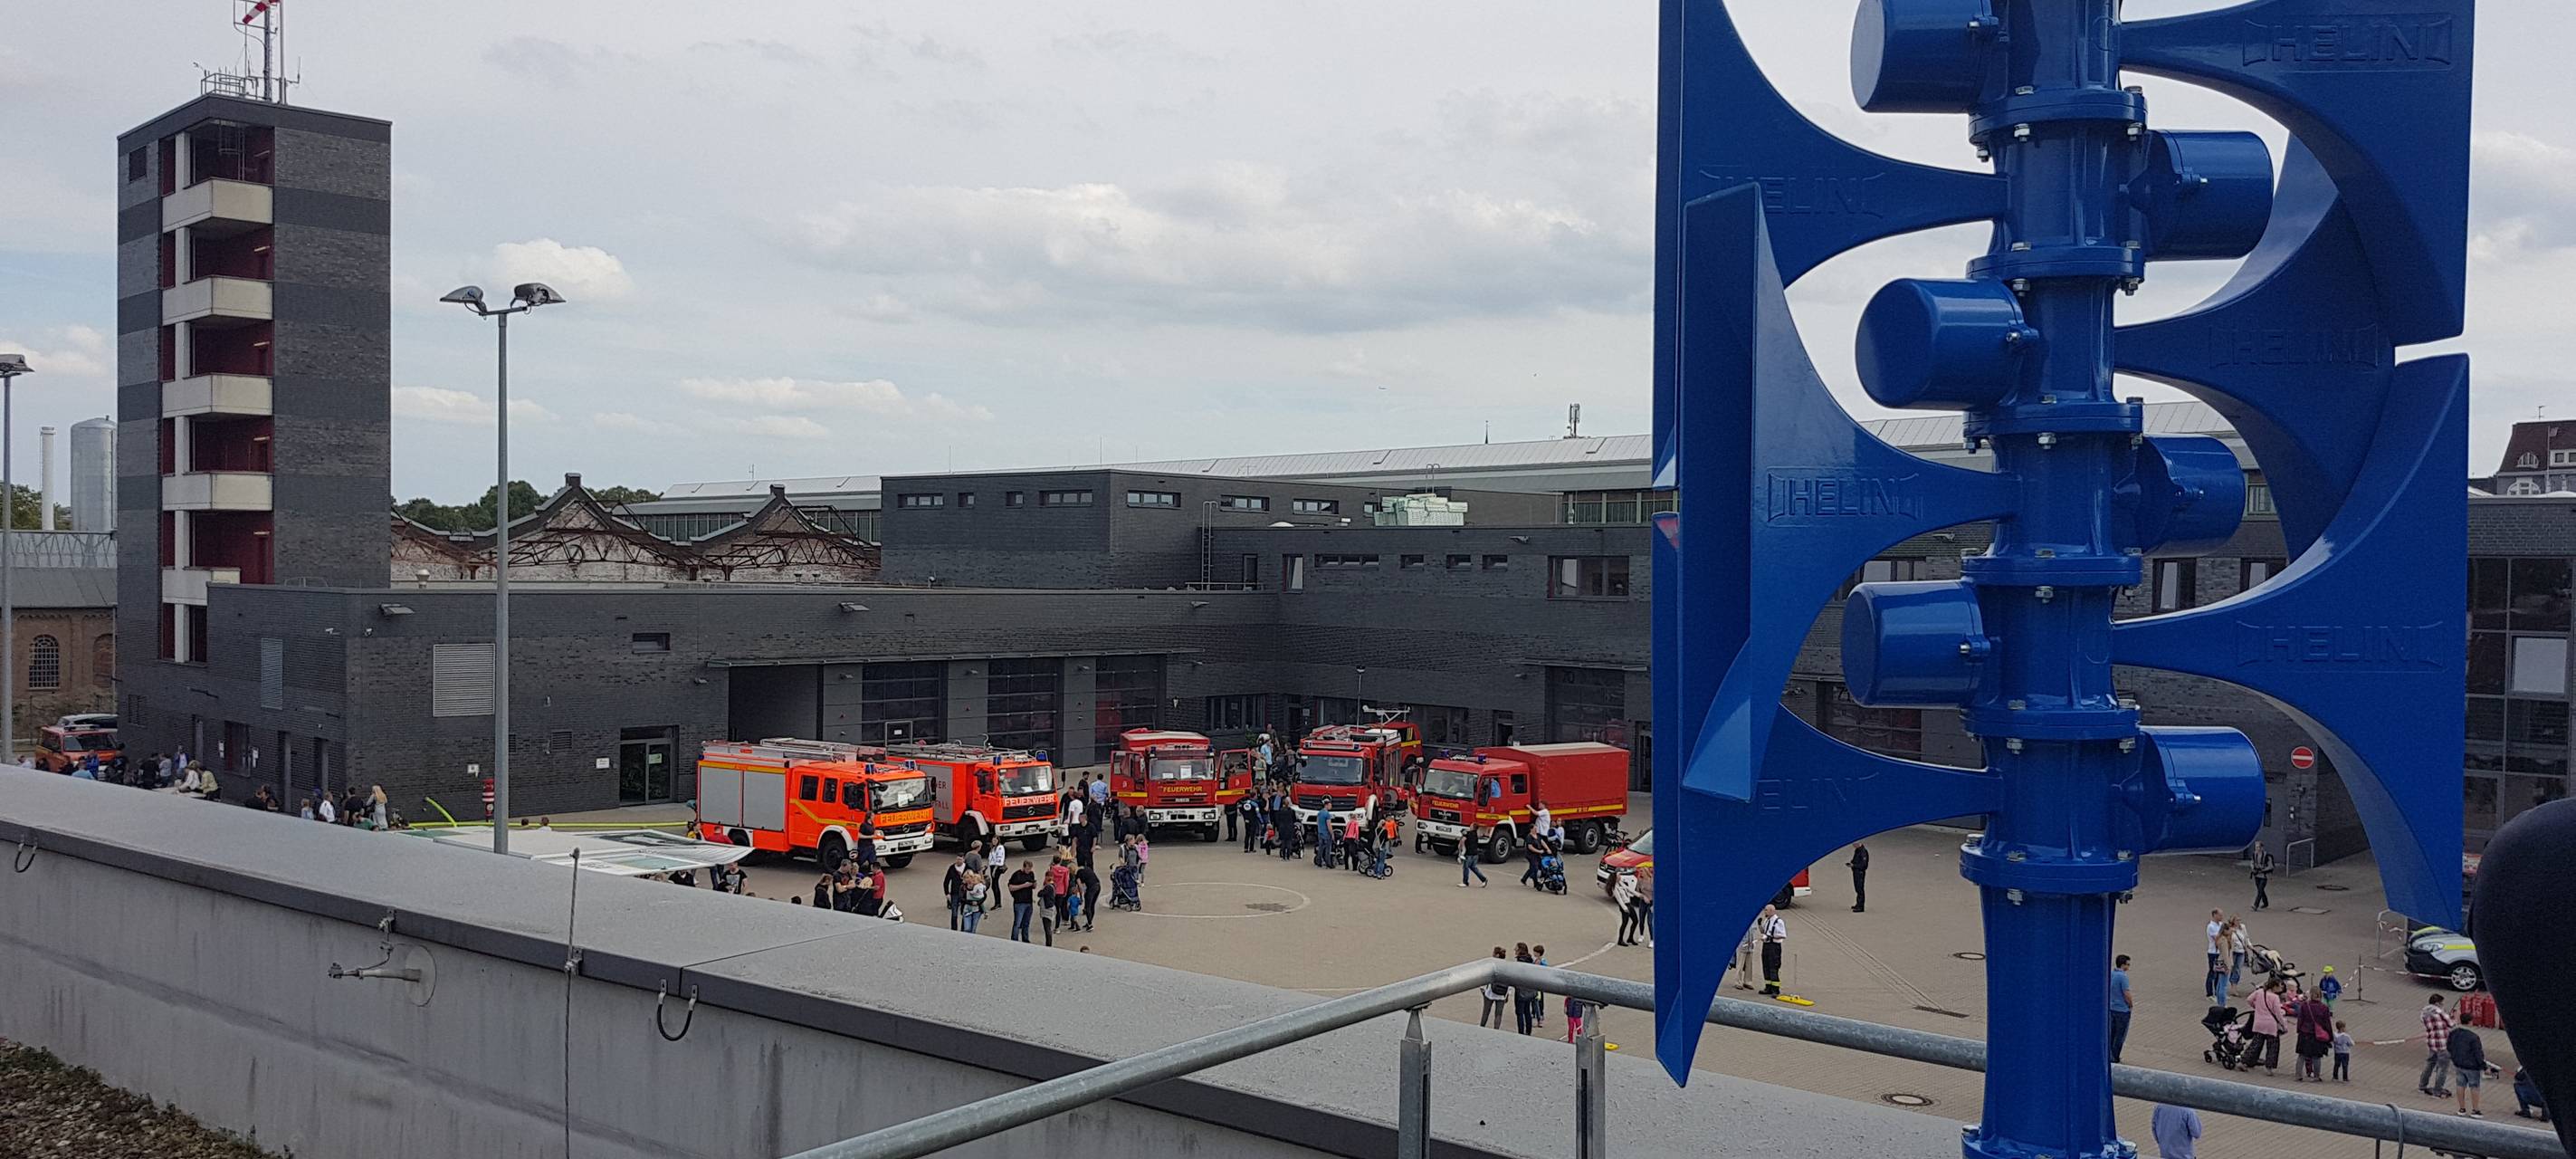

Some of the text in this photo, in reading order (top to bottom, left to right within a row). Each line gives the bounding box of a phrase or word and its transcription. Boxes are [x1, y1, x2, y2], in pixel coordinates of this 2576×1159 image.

[2272, 24, 2419, 62] HELIN
[1725, 177, 1856, 215] ELIN
[2231, 329, 2352, 365] HELIN
[1789, 478, 1895, 516] HELIN
[2266, 626, 2410, 662] HELIN
[1004, 794, 1055, 807] FEUERWEHR
[1757, 778, 1852, 814] ELIN
[881, 810, 930, 823] FEUERWEHR
